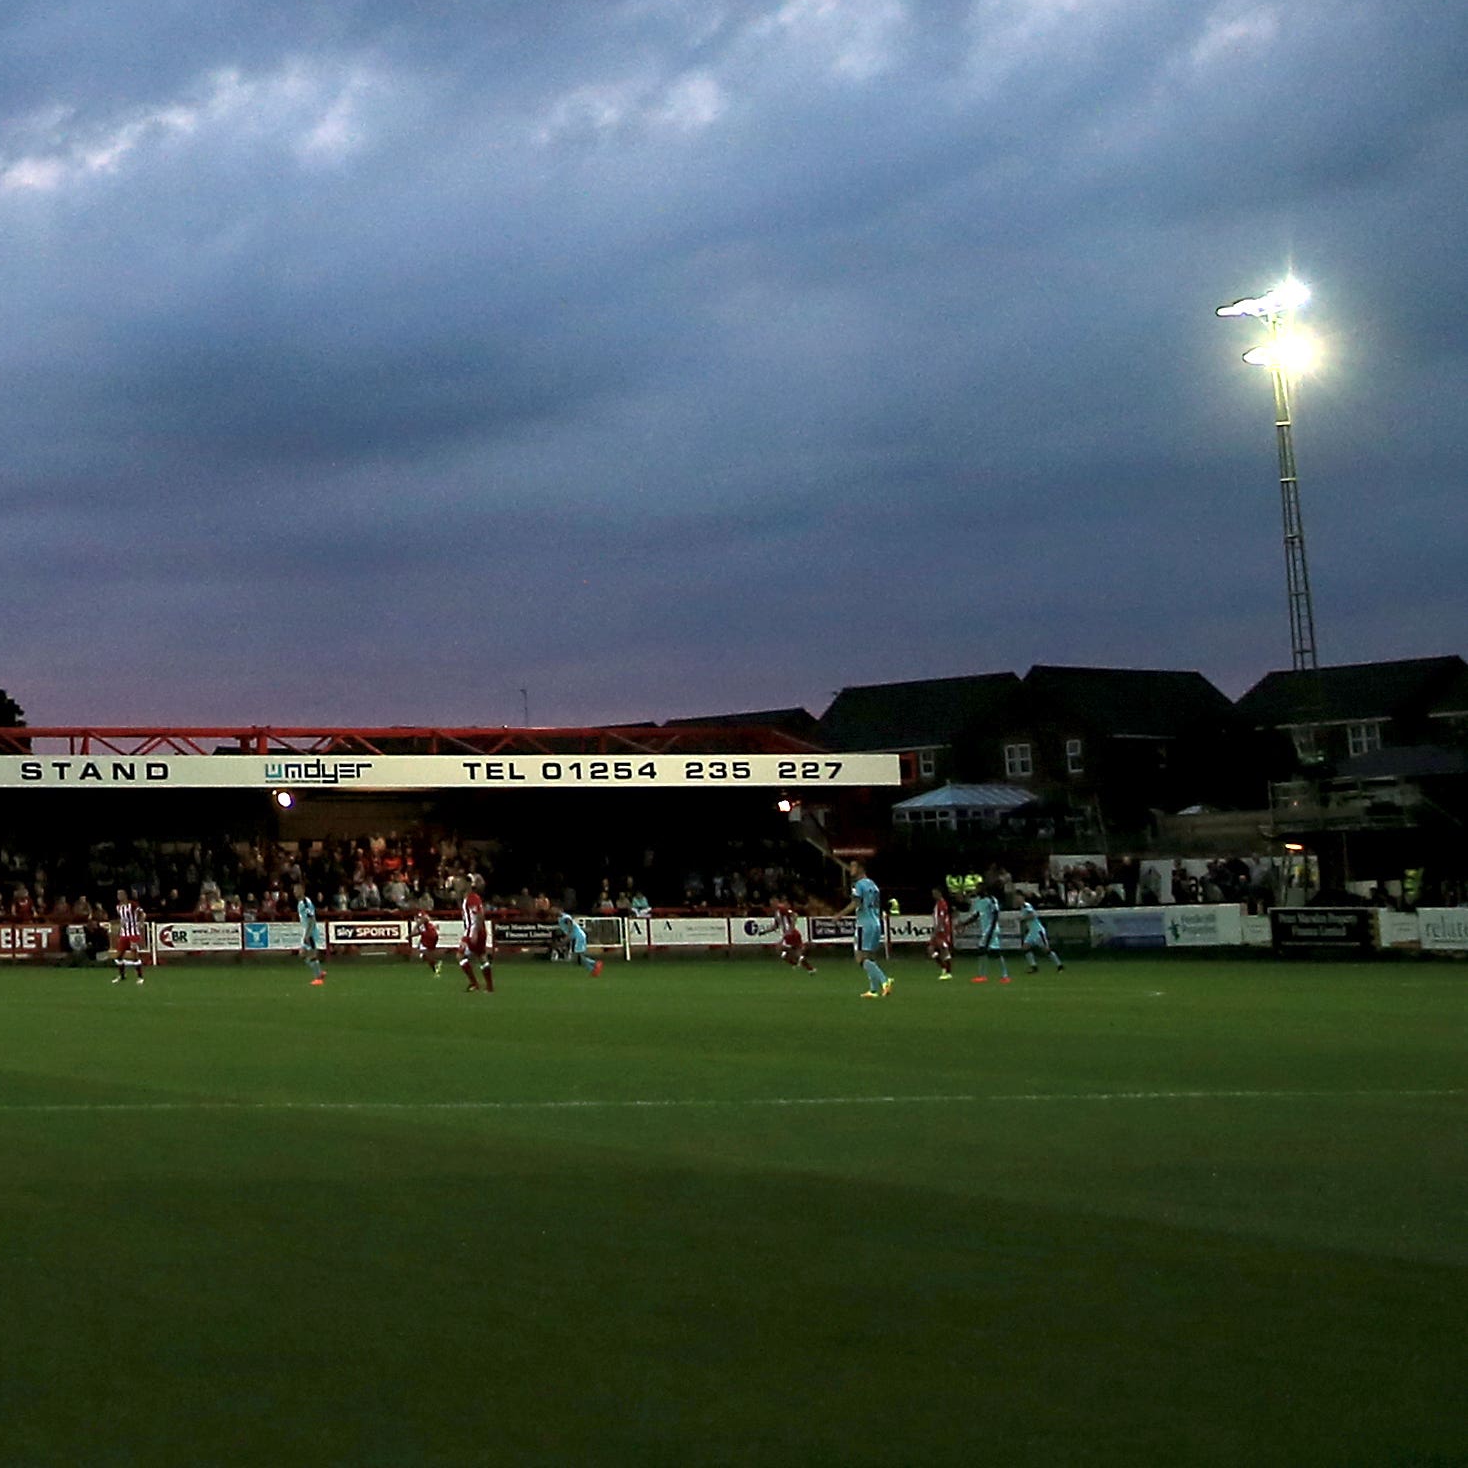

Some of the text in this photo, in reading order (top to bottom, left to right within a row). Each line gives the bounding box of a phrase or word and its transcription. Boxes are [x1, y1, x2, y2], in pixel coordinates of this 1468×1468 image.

[21, 762, 169, 781] STAND
[463, 761, 843, 780] TEL 01254 235 227
[356, 927, 400, 938] SPORTS
[888, 921, 935, 936] wha
[0, 928, 52, 949] BET
